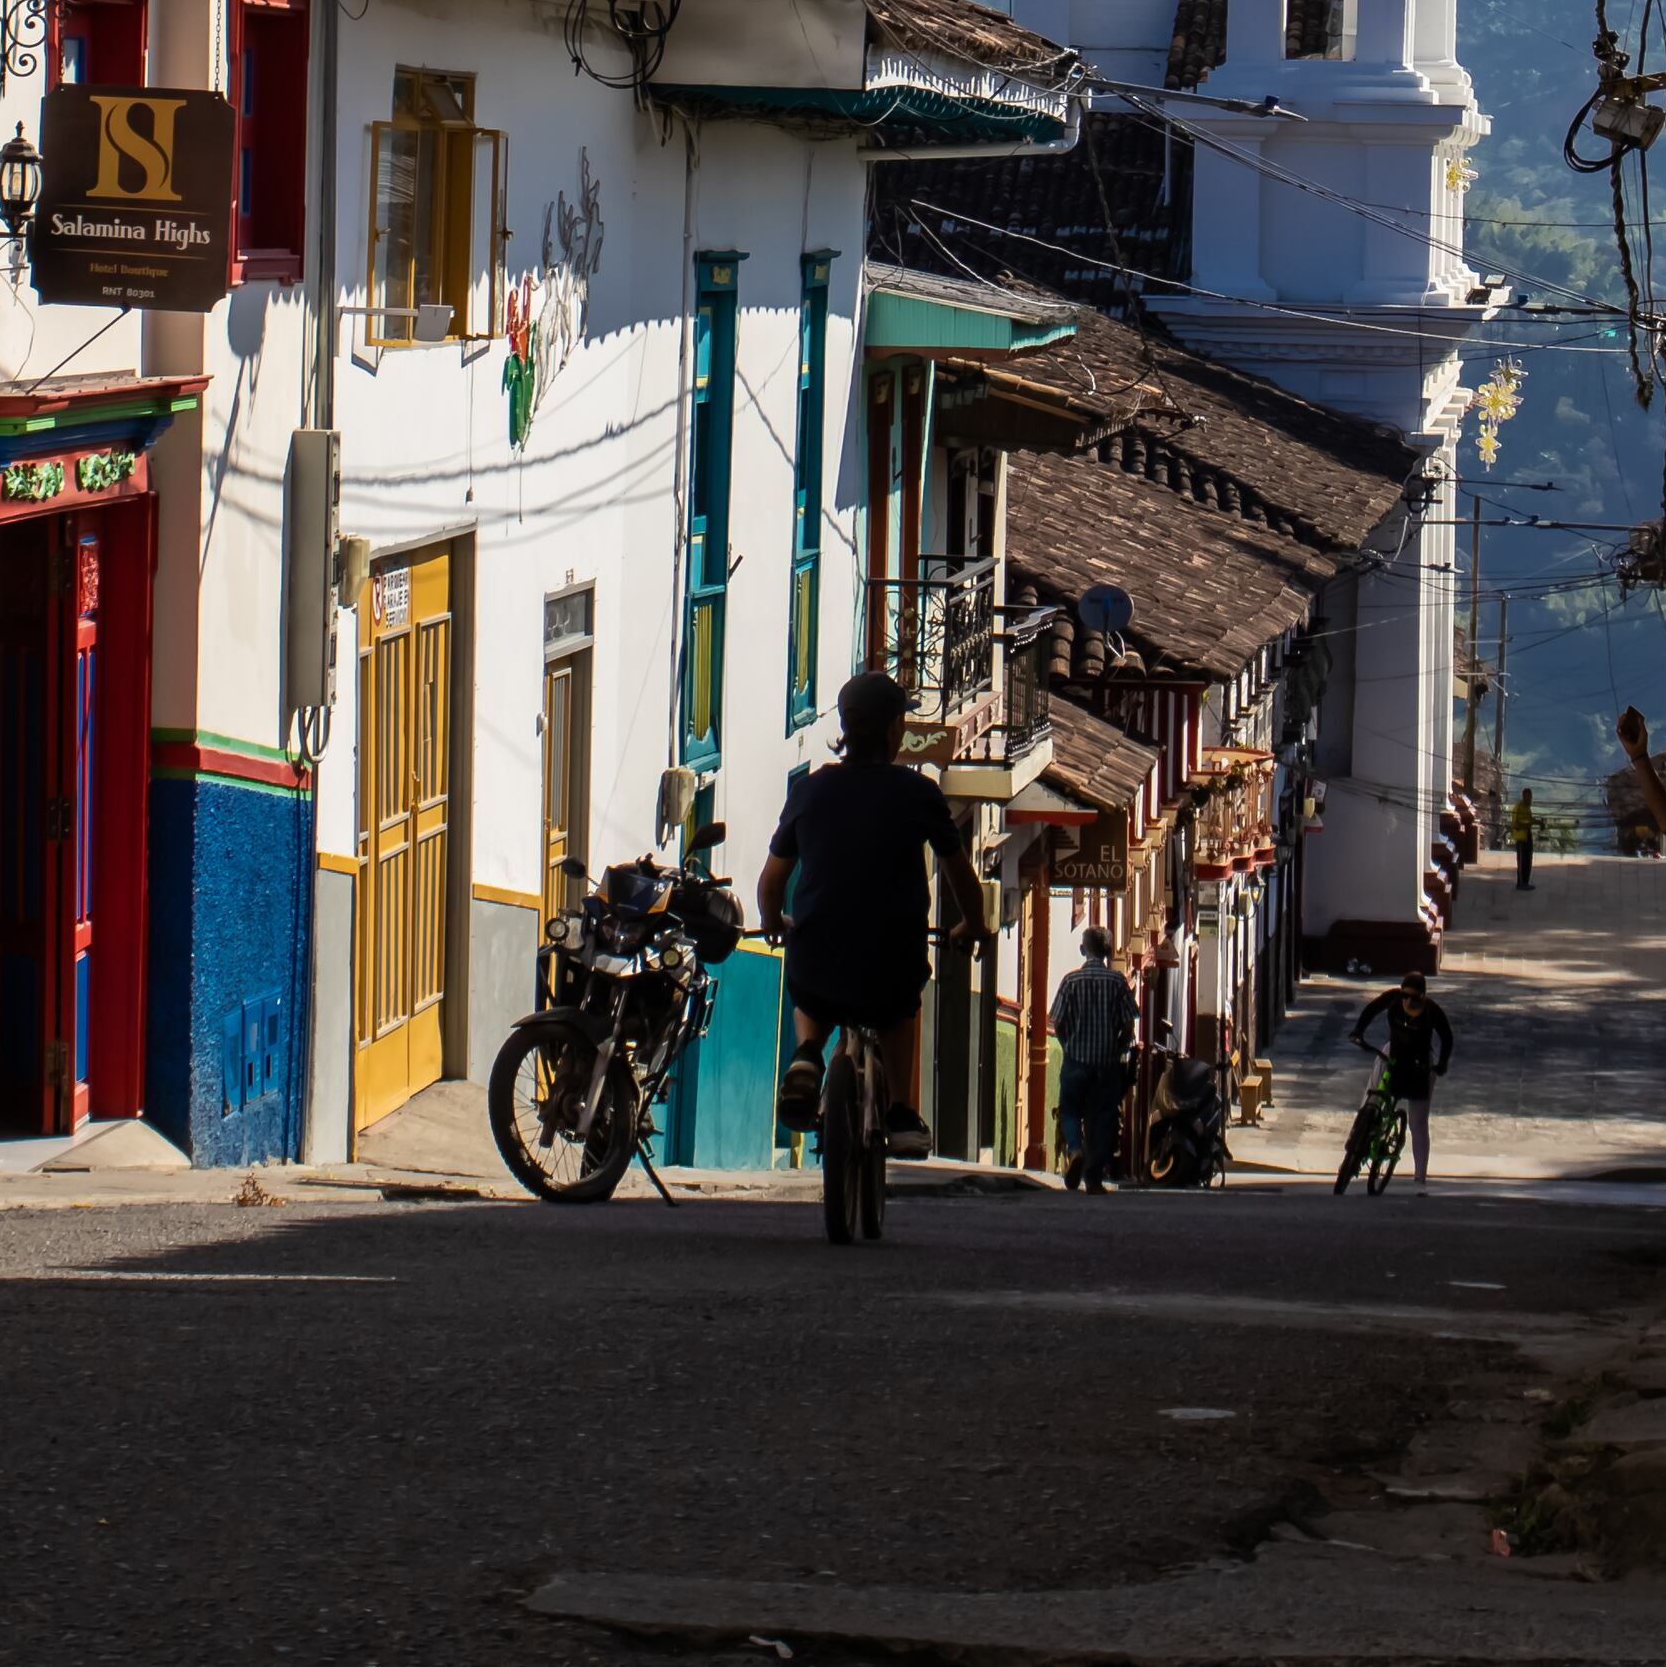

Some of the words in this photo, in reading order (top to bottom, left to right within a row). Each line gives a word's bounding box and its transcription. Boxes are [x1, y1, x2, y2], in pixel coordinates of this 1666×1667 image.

[51, 213, 146, 240] Salamina
[155, 219, 211, 250] Highs
[1100, 845, 1121, 862] EL
